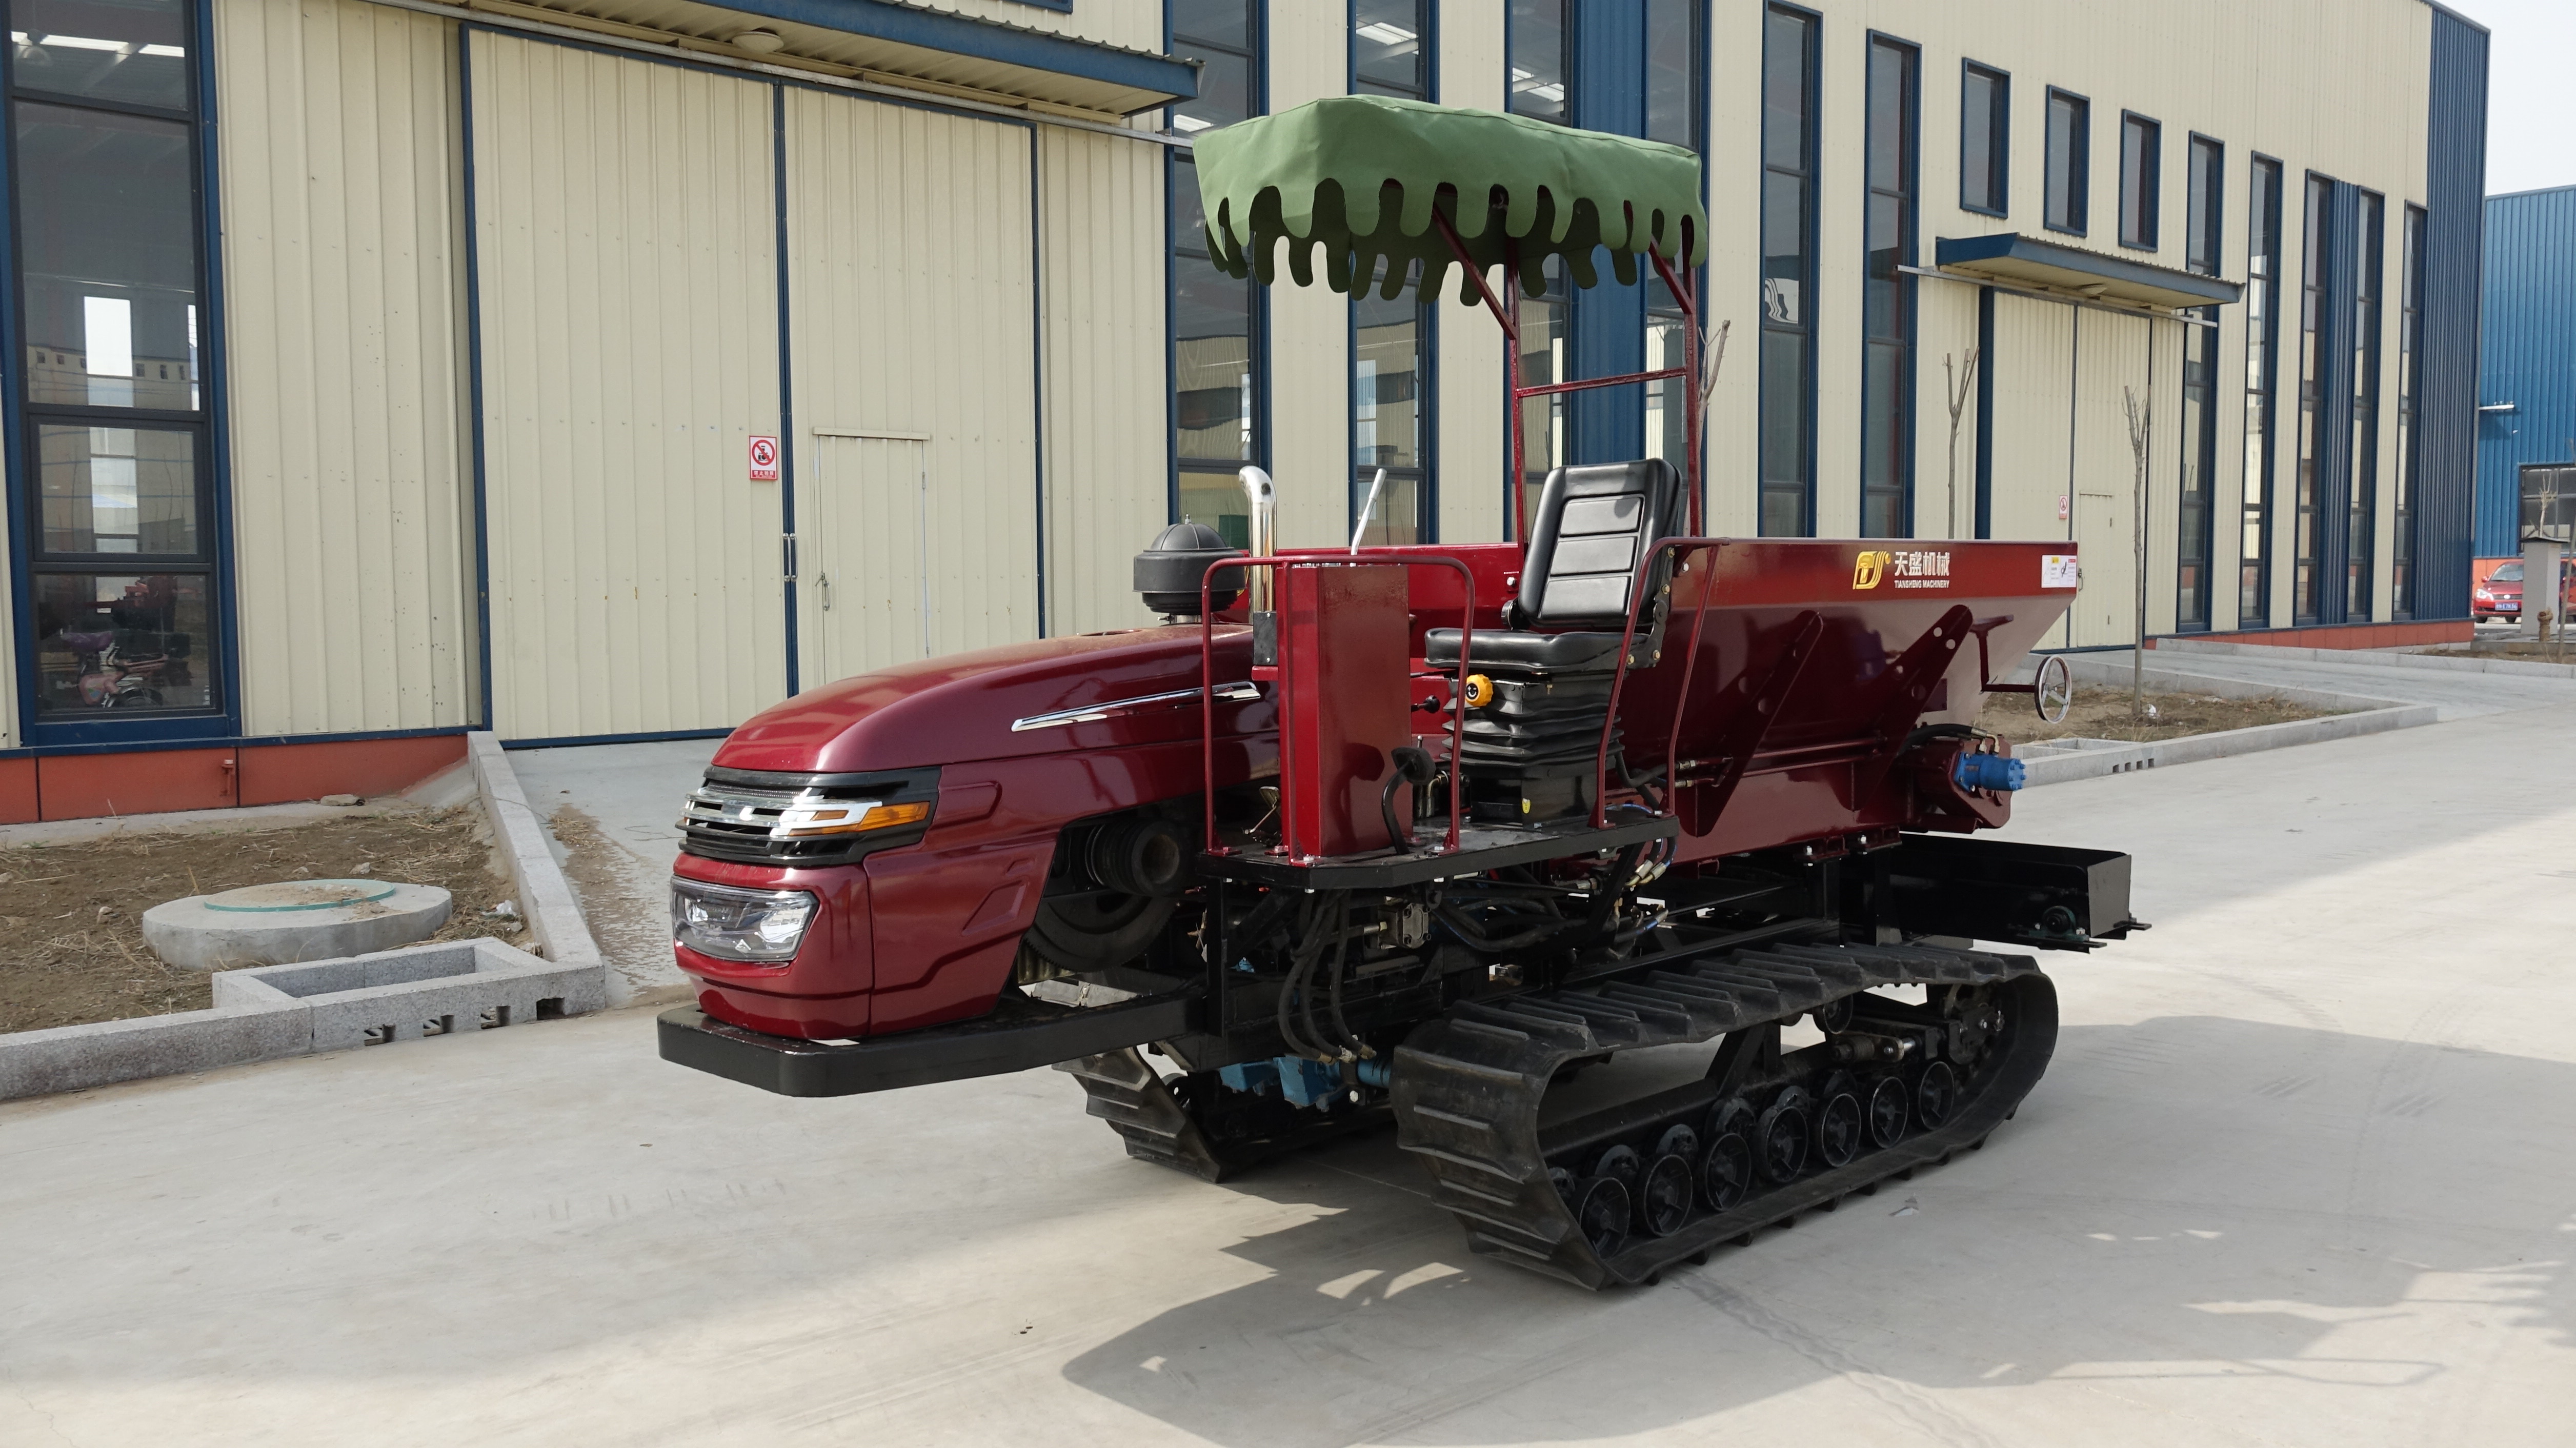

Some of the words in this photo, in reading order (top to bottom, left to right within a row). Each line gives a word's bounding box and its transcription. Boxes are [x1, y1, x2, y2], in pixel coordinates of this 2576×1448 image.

[1895, 552, 1950, 576] 天盛机械
[1895, 580, 1922, 588] TIANSHENG
[1922, 580, 1950, 588] MACHINERY
